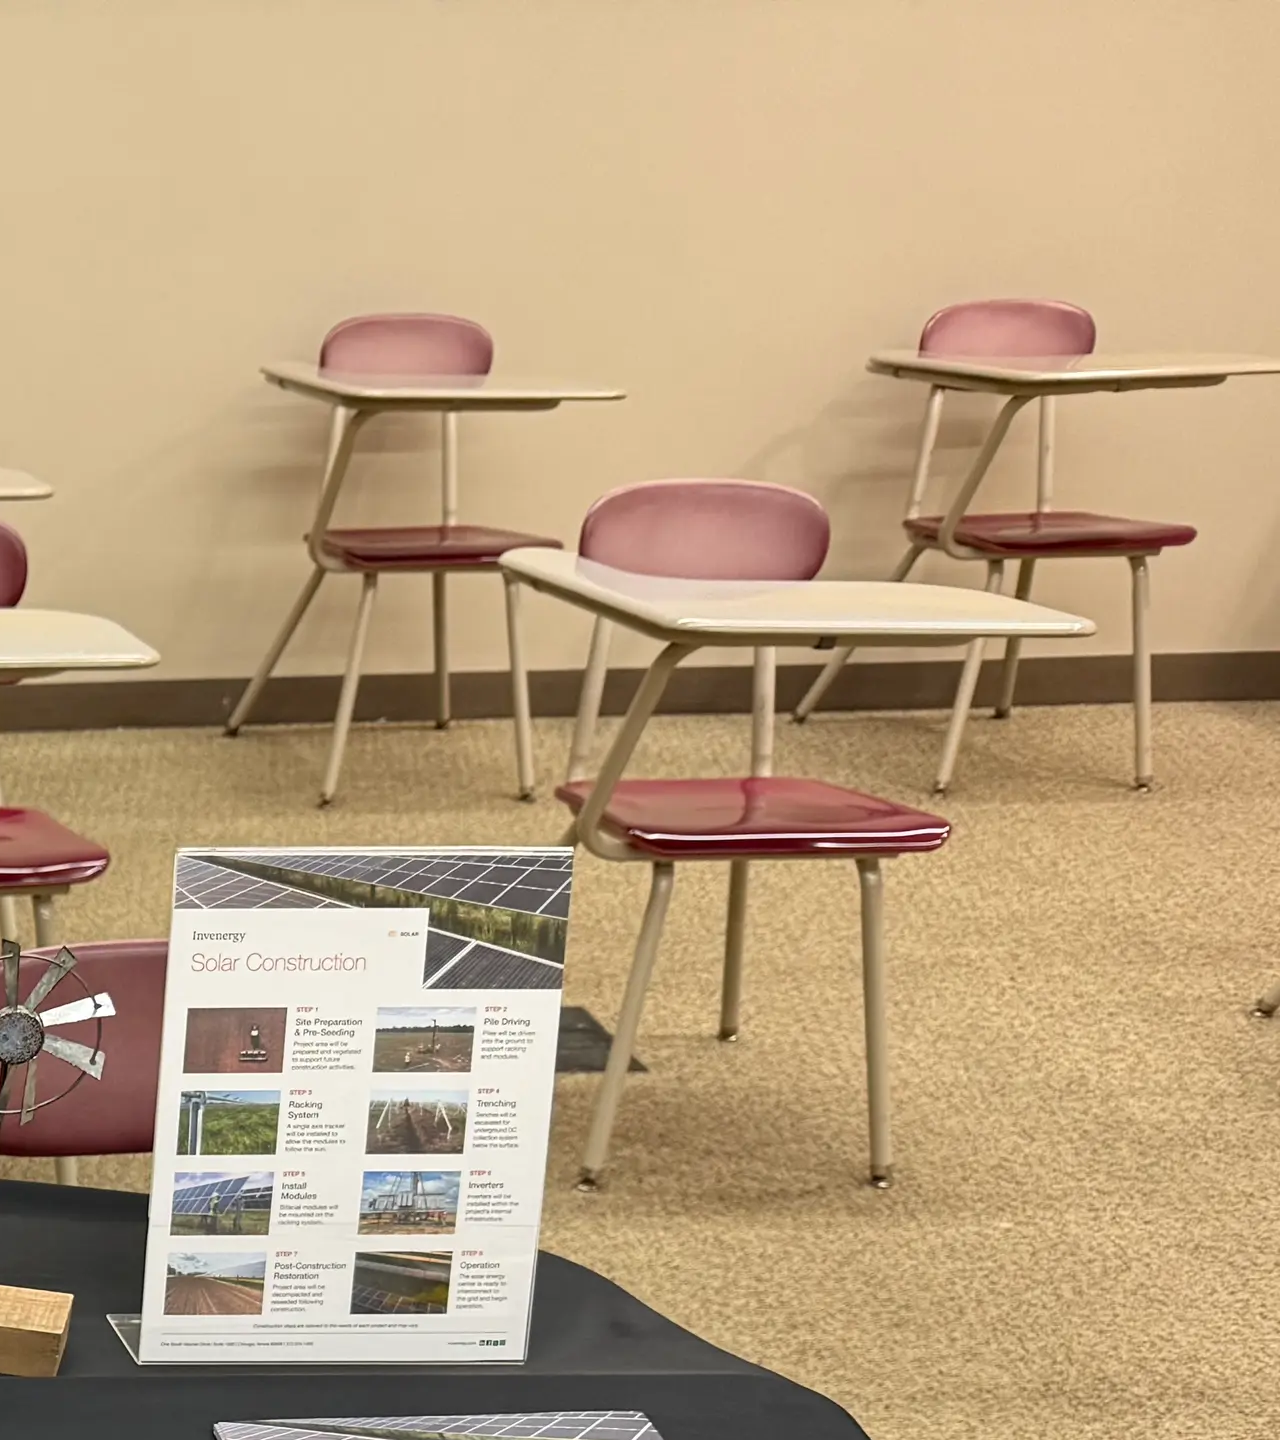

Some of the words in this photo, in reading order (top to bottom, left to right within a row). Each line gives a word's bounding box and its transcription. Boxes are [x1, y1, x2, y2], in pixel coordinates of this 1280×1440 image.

[192, 931, 246, 942] Invenergy
[191, 953, 241, 972] Solar
[246, 952, 367, 972] Construction
[295, 1018, 312, 1026] Site
[314, 1018, 363, 1027] Preparation
[484, 1018, 500, 1026] Pile
[501, 1018, 531, 1027] Driving
[302, 1028, 355, 1038] Pre-Seeding
[289, 1100, 323, 1109] Racking
[476, 1099, 517, 1109] Trenching
[288, 1111, 319, 1120] System
[281, 1182, 307, 1190] Install
[468, 1181, 504, 1189] Inverters
[280, 1192, 317, 1200] Modules
[274, 1262, 346, 1270] Post-Construction
[460, 1261, 500, 1270] Operation
[273, 1272, 319, 1280] Restoration
